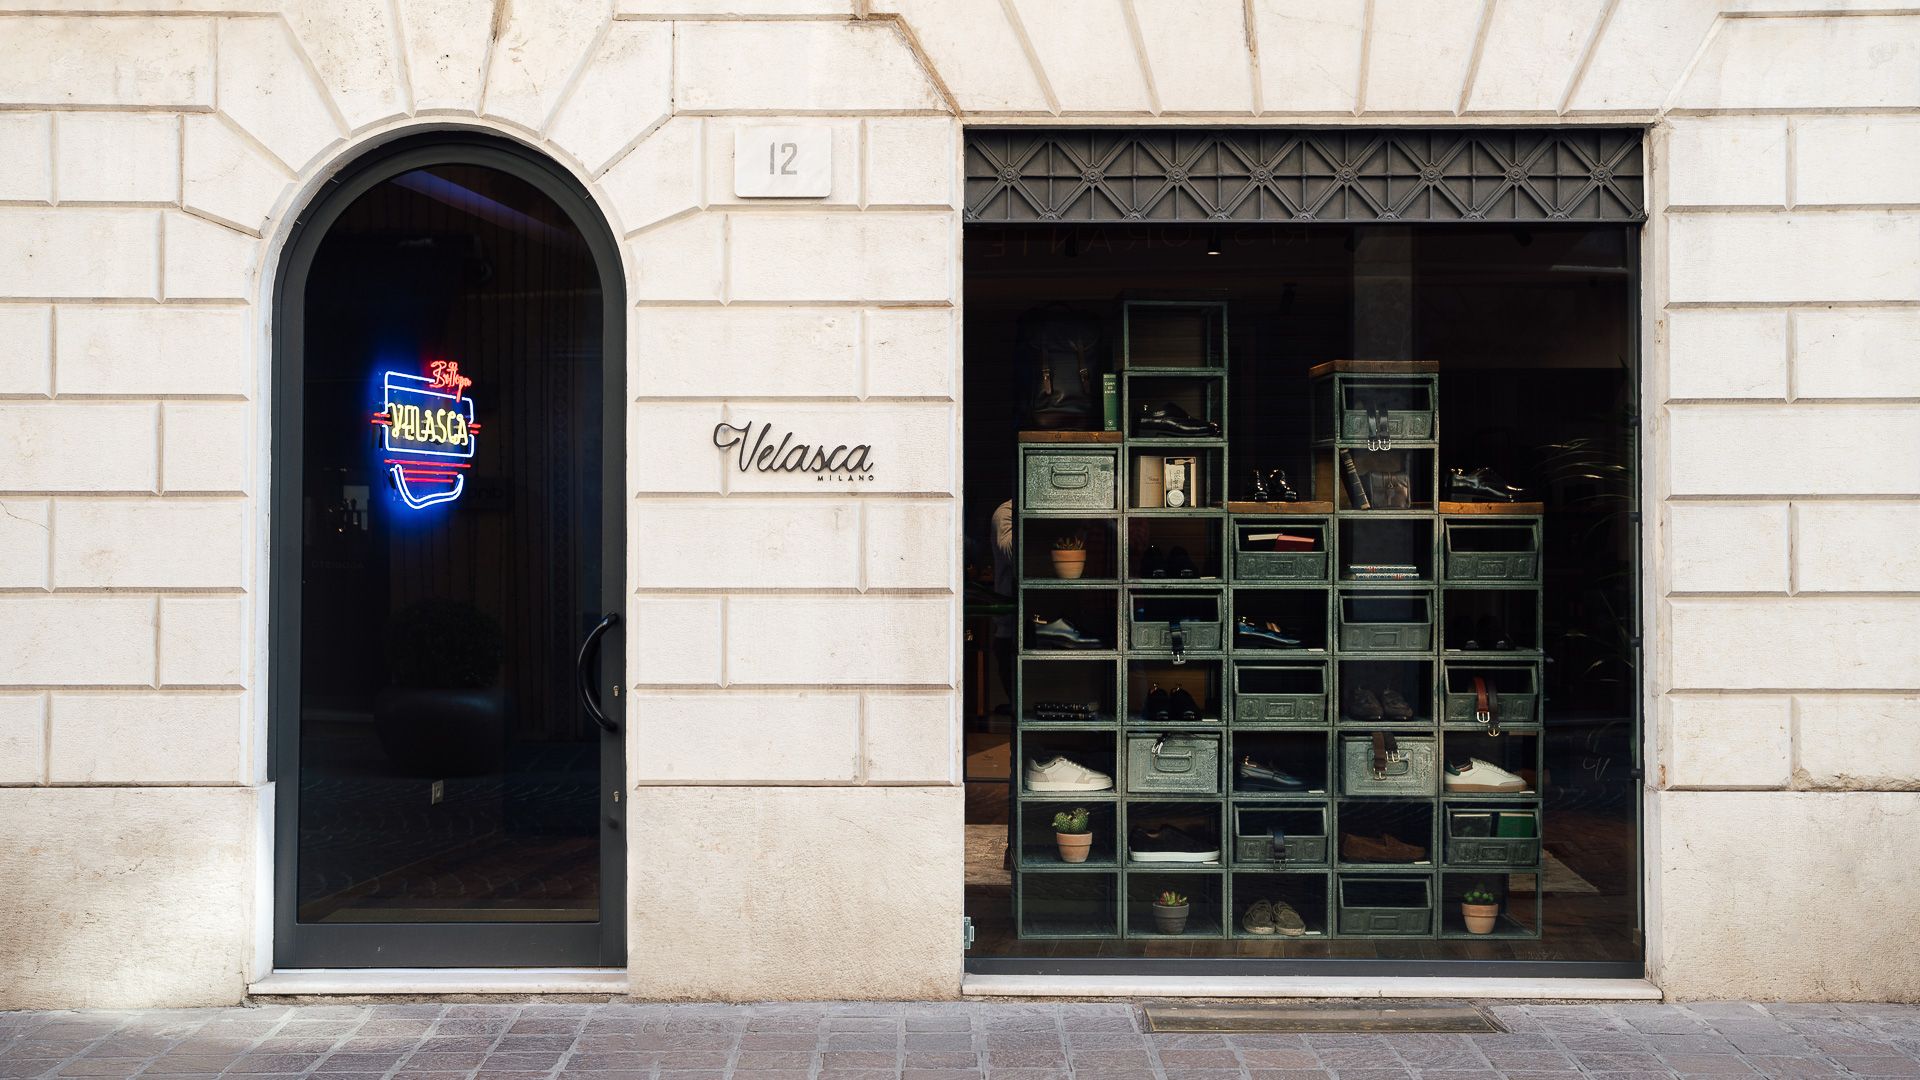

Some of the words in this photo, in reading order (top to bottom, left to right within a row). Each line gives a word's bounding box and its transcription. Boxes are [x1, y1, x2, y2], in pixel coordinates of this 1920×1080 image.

[770, 142, 797, 175] 12
[430, 360, 472, 403] Bottega
[387, 402, 469, 446] VELASCA
[713, 420, 874, 473] Velasca
